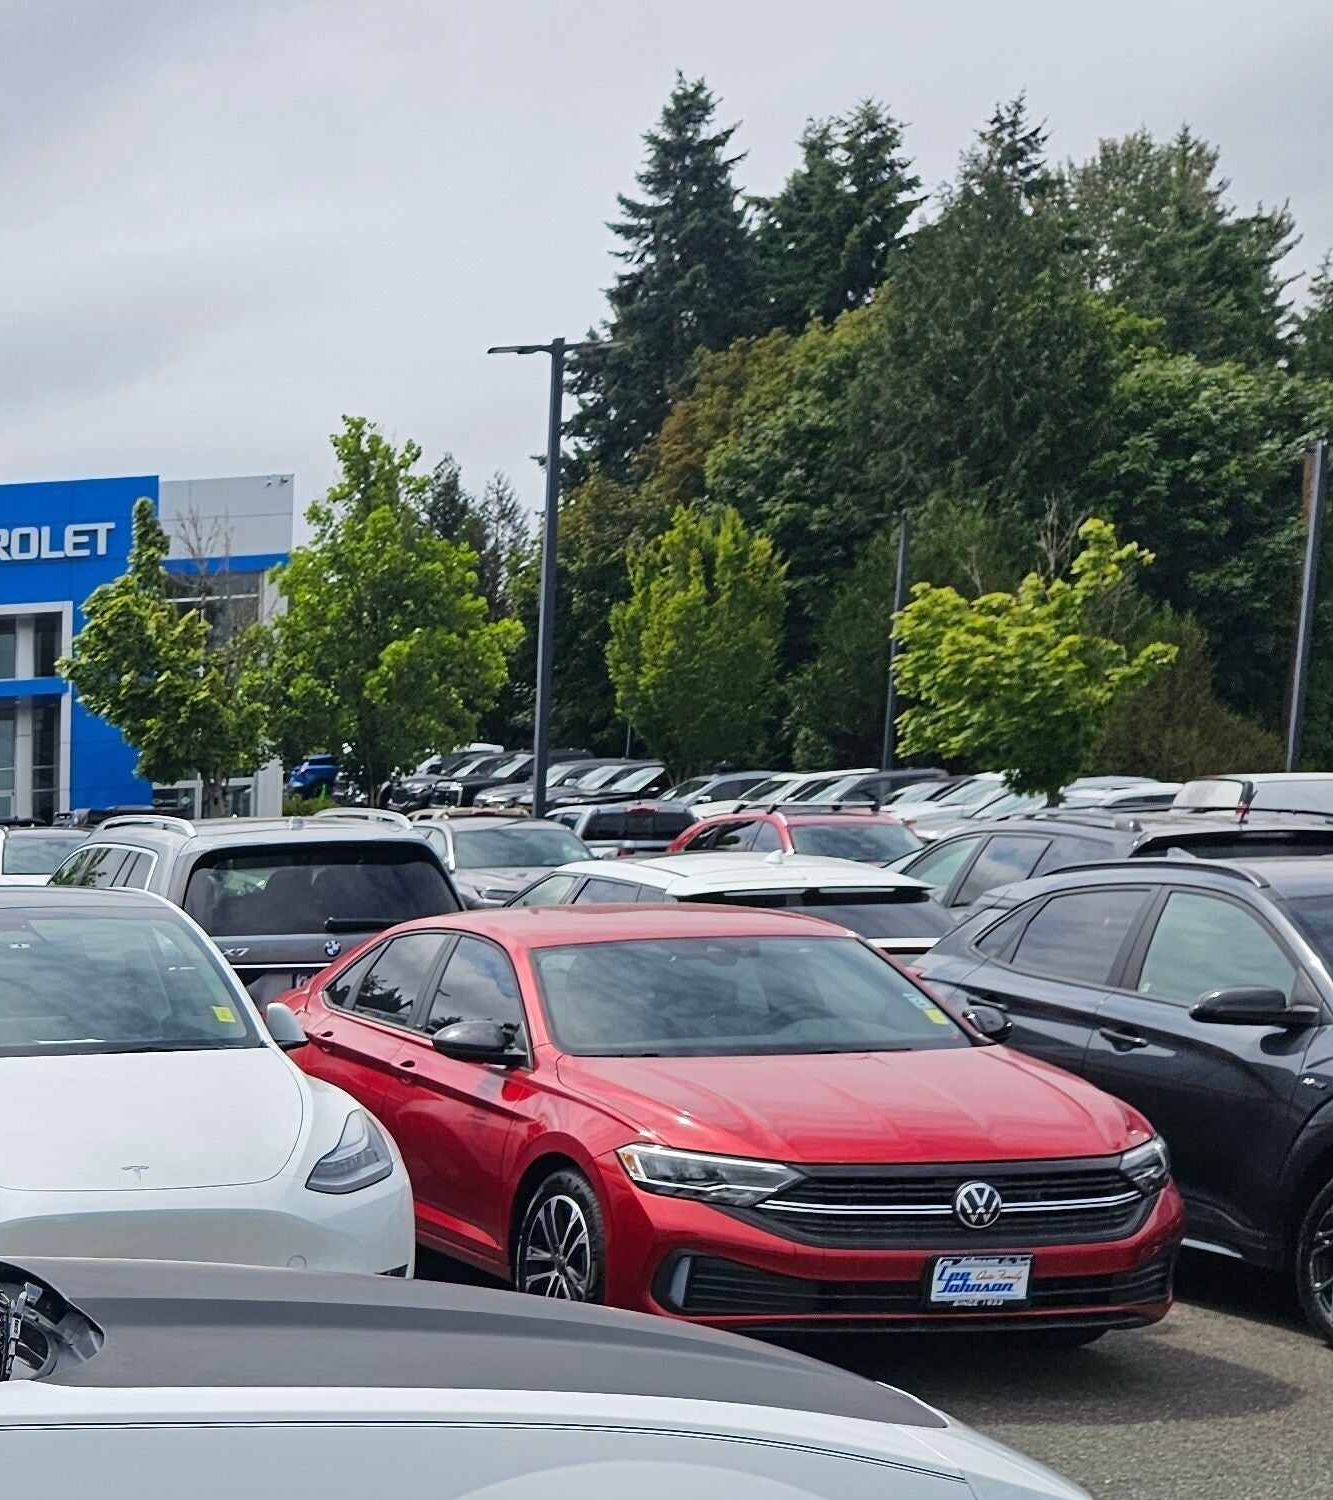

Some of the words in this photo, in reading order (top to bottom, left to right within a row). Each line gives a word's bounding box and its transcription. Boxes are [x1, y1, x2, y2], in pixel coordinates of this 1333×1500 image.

[222, 947, 249, 957] X7
[937, 1265, 971, 1281] Lee
[937, 1278, 1015, 1293] Johnson
